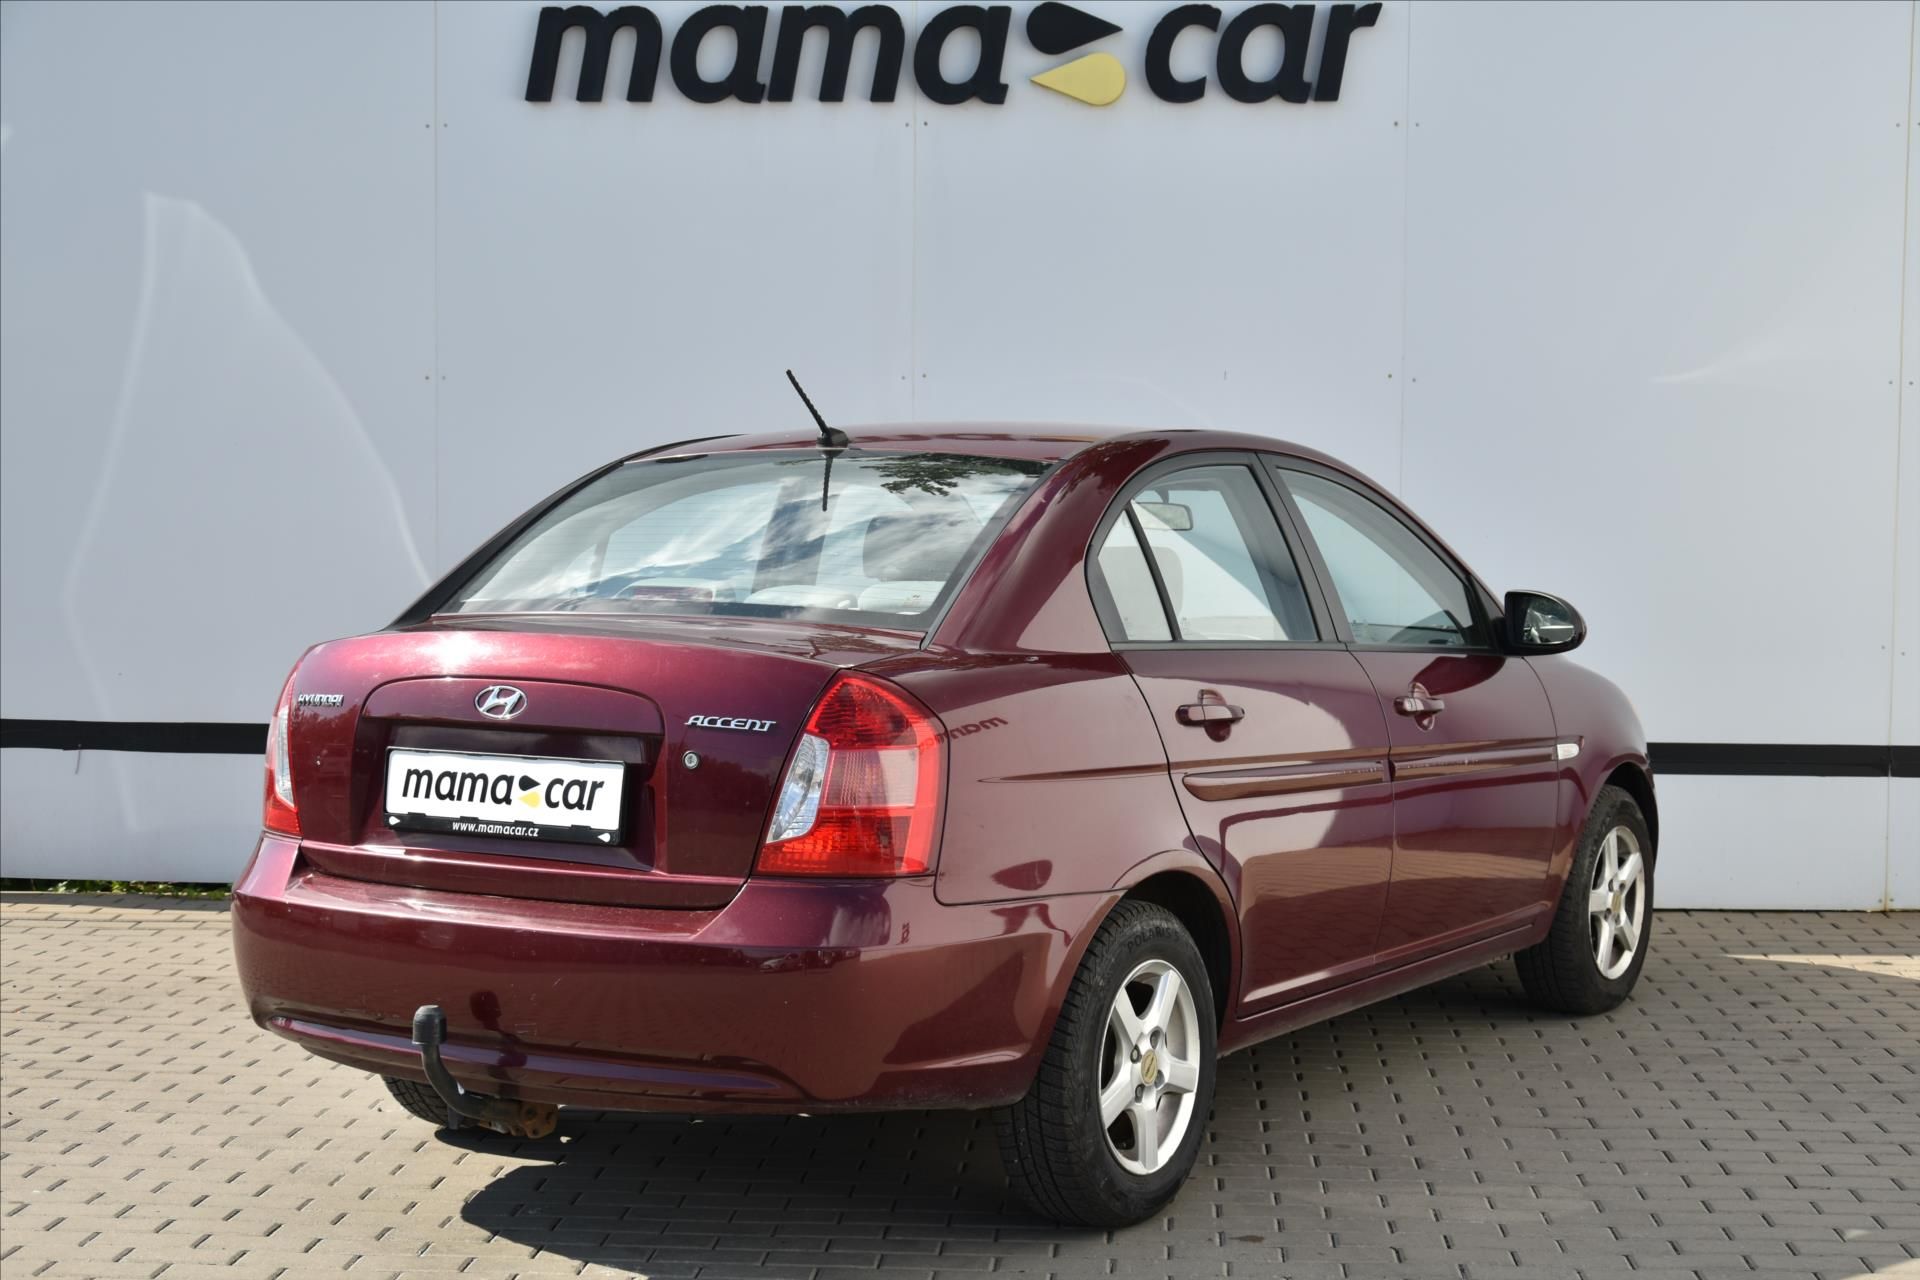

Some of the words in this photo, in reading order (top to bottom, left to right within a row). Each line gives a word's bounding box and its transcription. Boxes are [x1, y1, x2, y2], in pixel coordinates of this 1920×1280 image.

[525, 4, 1009, 105] mama
[1145, 2, 1383, 104] car
[684, 715, 777, 731] ACCENT
[402, 768, 515, 806] mama
[545, 777, 605, 811] car
[452, 821, 539, 837] www.mamacar.cz
